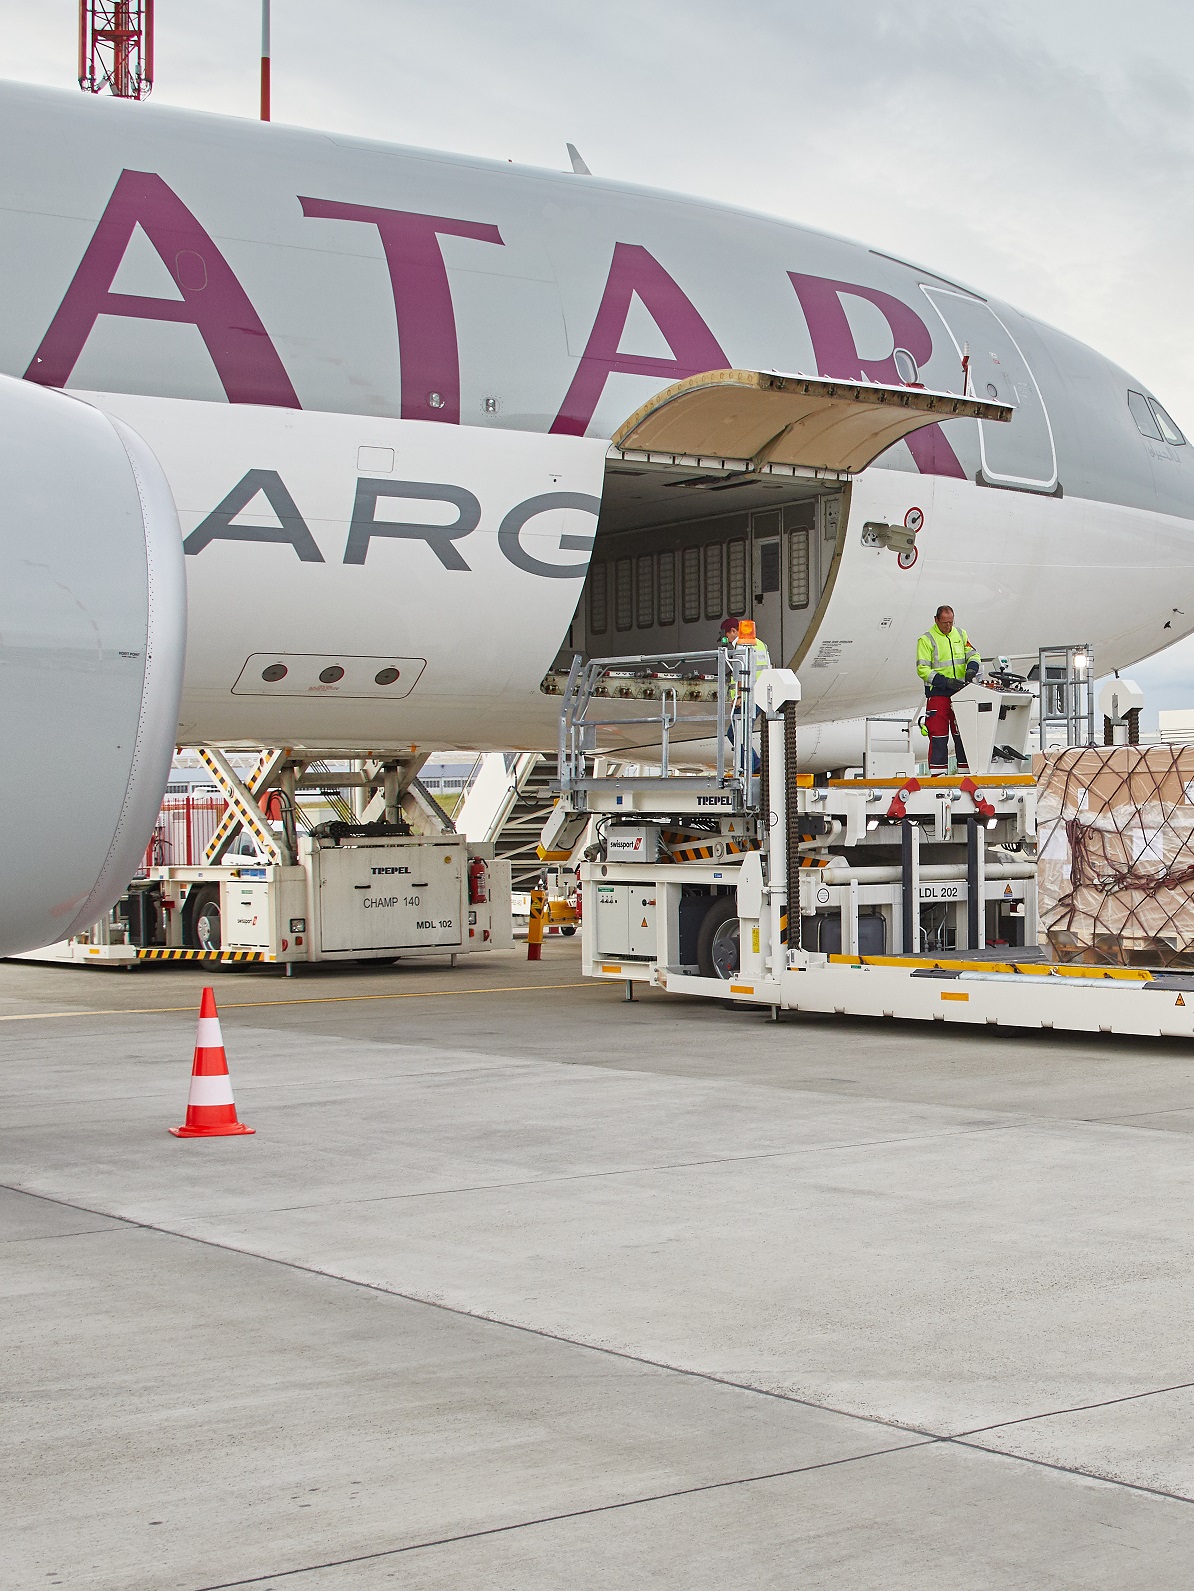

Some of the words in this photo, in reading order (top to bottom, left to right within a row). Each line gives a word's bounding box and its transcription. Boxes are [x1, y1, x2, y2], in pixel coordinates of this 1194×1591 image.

[696, 796, 732, 805] TREPEL
[610, 838, 634, 850] swissport
[371, 866, 411, 875] TREPEL
[919, 887, 938, 898] LDL
[941, 887, 958, 898] 202
[363, 897, 398, 908] CHAMP
[403, 896, 420, 906] 140
[416, 920, 436, 929] MDL
[438, 920, 453, 928] 102
